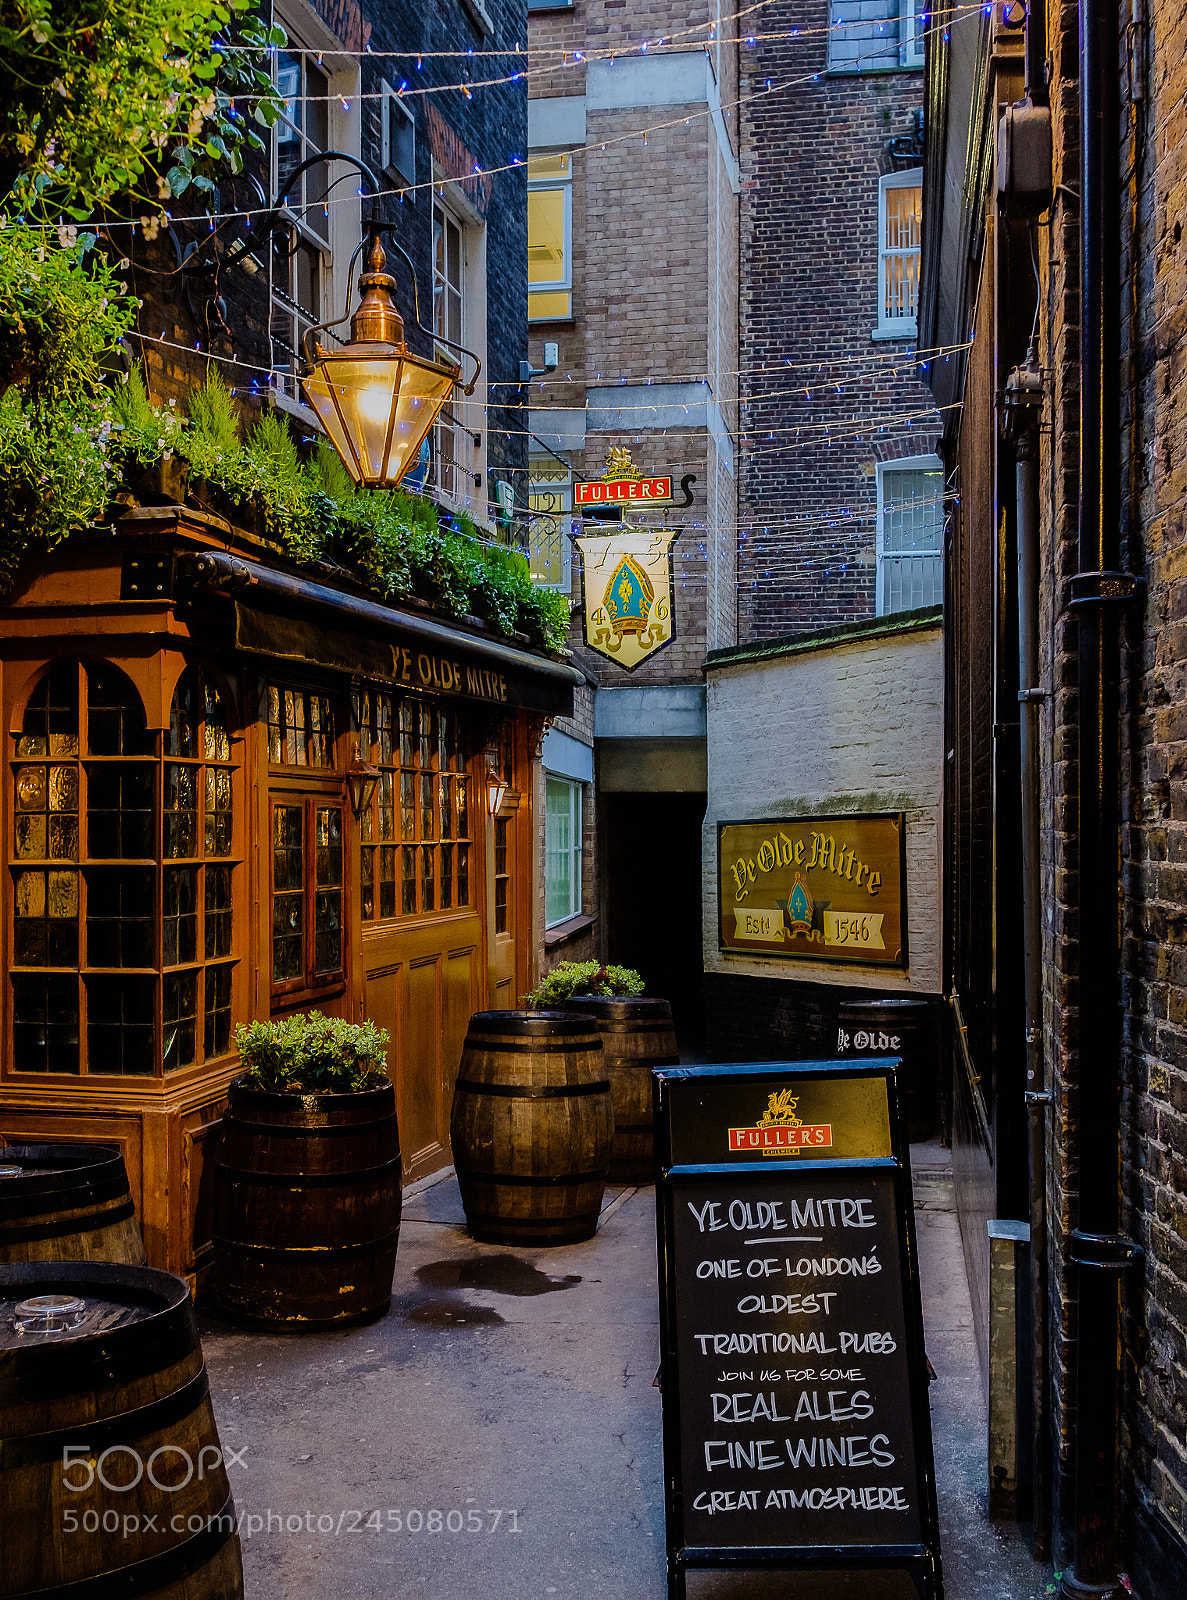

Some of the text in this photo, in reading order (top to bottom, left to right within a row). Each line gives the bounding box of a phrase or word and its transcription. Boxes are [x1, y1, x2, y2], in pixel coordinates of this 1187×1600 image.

[579, 479, 665, 500] FULLER'S
[591, 596, 669, 626] 4 6
[389, 644, 507, 702] YE OLDE MITRE
[730, 831, 882, 902] Ye Olde Mitre
[834, 916, 870, 944] 1546
[853, 1030, 901, 1050] Olde
[736, 1127, 824, 1147] FULLER'S
[688, 1198, 877, 1232] YE OLDE MITRE
[696, 1246, 882, 1279] ONE OF LONDON'S
[737, 1292, 838, 1314] OLDEST
[694, 1332, 897, 1355] TRADITIONAL PUBS
[717, 1368, 866, 1382] JOIN US FOR SOME
[710, 1390, 875, 1423] REAL ALES
[704, 1433, 896, 1471] FINE WINES
[693, 1486, 910, 1515] GREAT ATMOSPHERE
